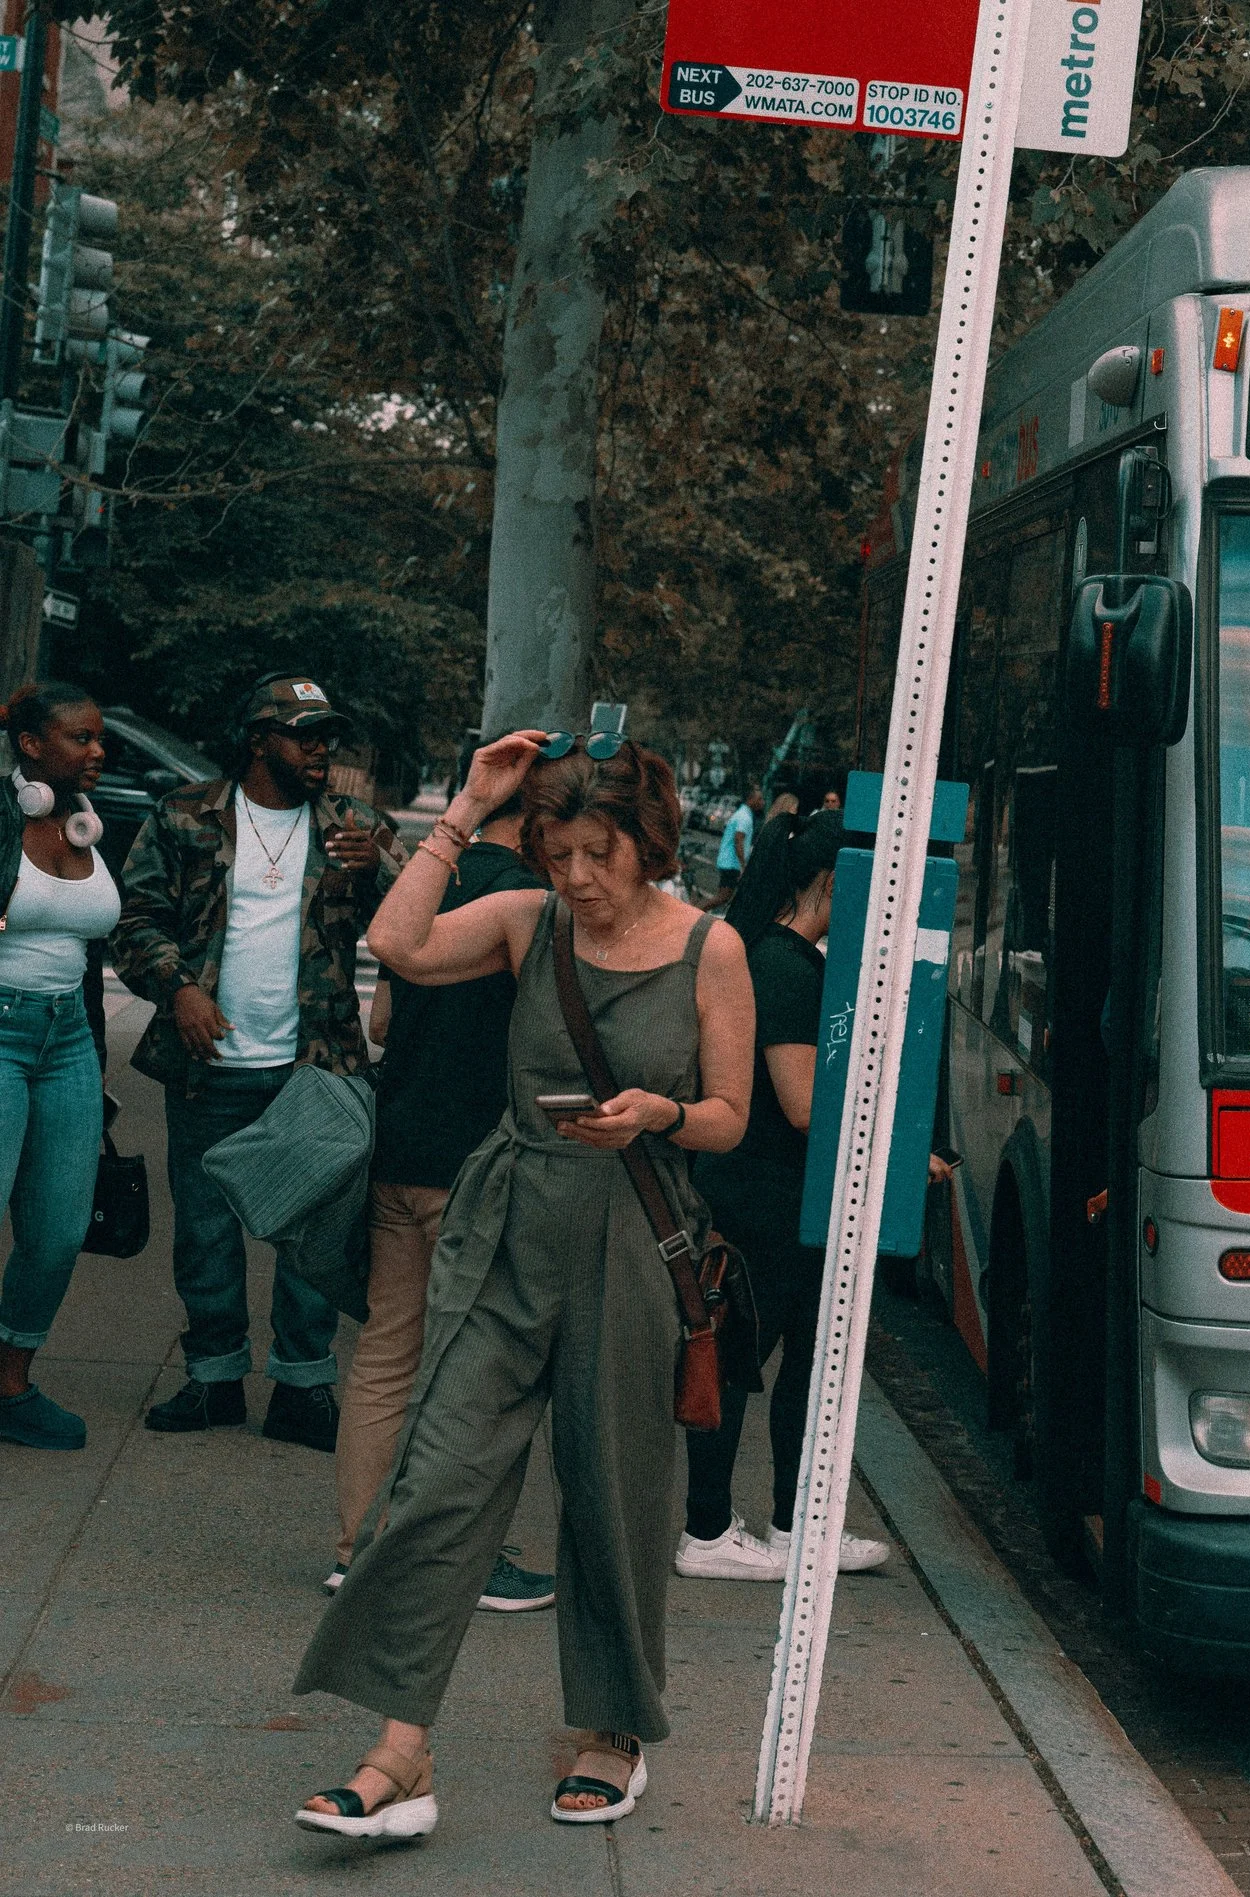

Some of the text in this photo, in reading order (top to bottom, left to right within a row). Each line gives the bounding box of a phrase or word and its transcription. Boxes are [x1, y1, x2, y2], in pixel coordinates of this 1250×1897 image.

[677, 67, 722, 84] NEXT
[746, 74, 855, 97] 202-637-7000
[679, 89, 715, 105] BUS
[868, 84, 961, 106] STOP ID NO.
[745, 95, 853, 118] WMATA.COM
[867, 105, 955, 131] 1003746
